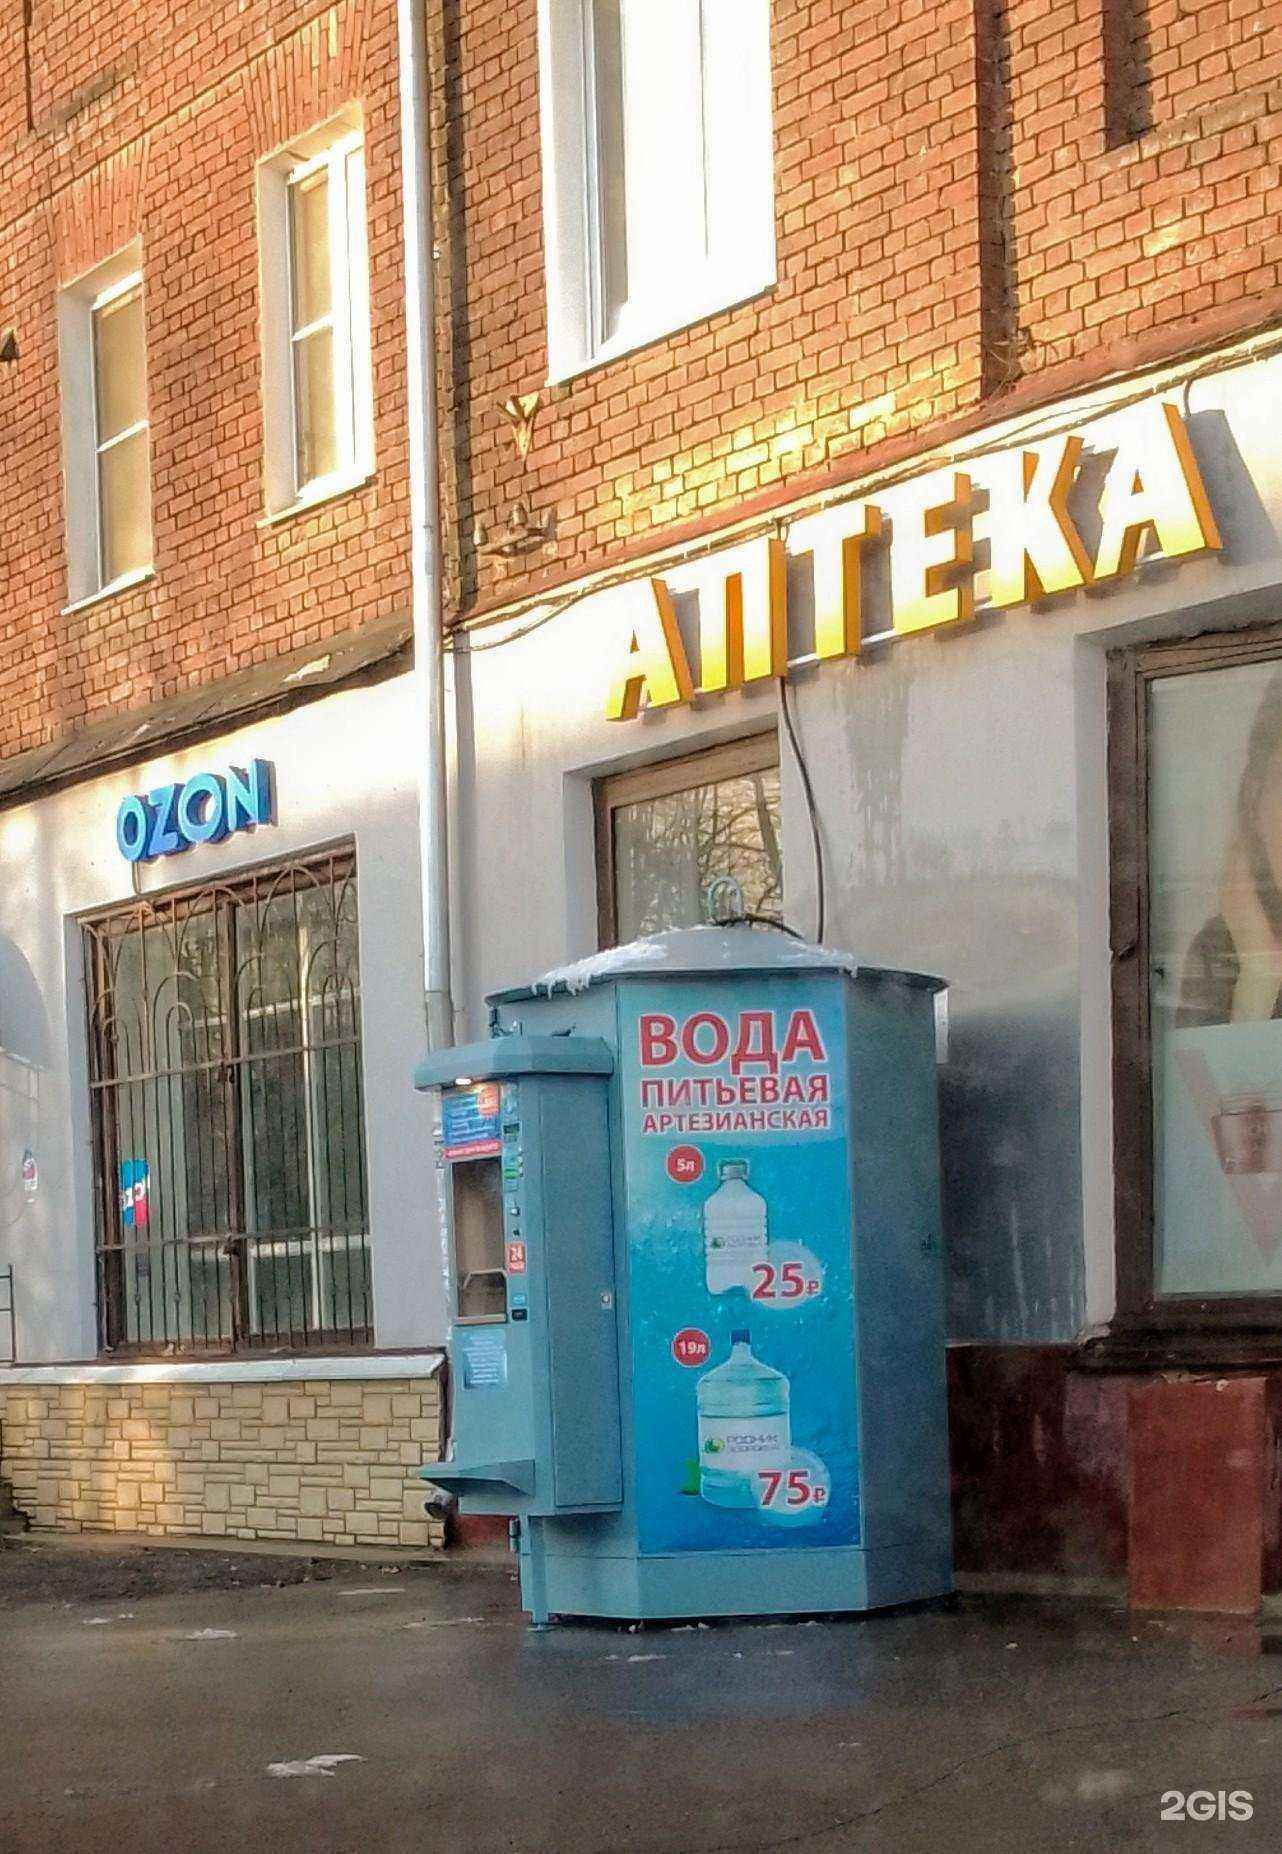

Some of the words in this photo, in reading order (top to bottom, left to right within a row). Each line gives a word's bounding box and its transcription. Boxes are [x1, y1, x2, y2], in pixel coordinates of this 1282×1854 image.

[606, 401, 1222, 721] АПТЕКА
[116, 757, 270, 863] OZON
[639, 1009, 828, 1077] ВОДА
[640, 1073, 830, 1108] ПИТЬЕВАЯ
[642, 1108, 830, 1134] АРТЕЗИАНСКАЯ
[677, 1158, 695, 1172] 5л
[678, 1341, 707, 1355] 19л
